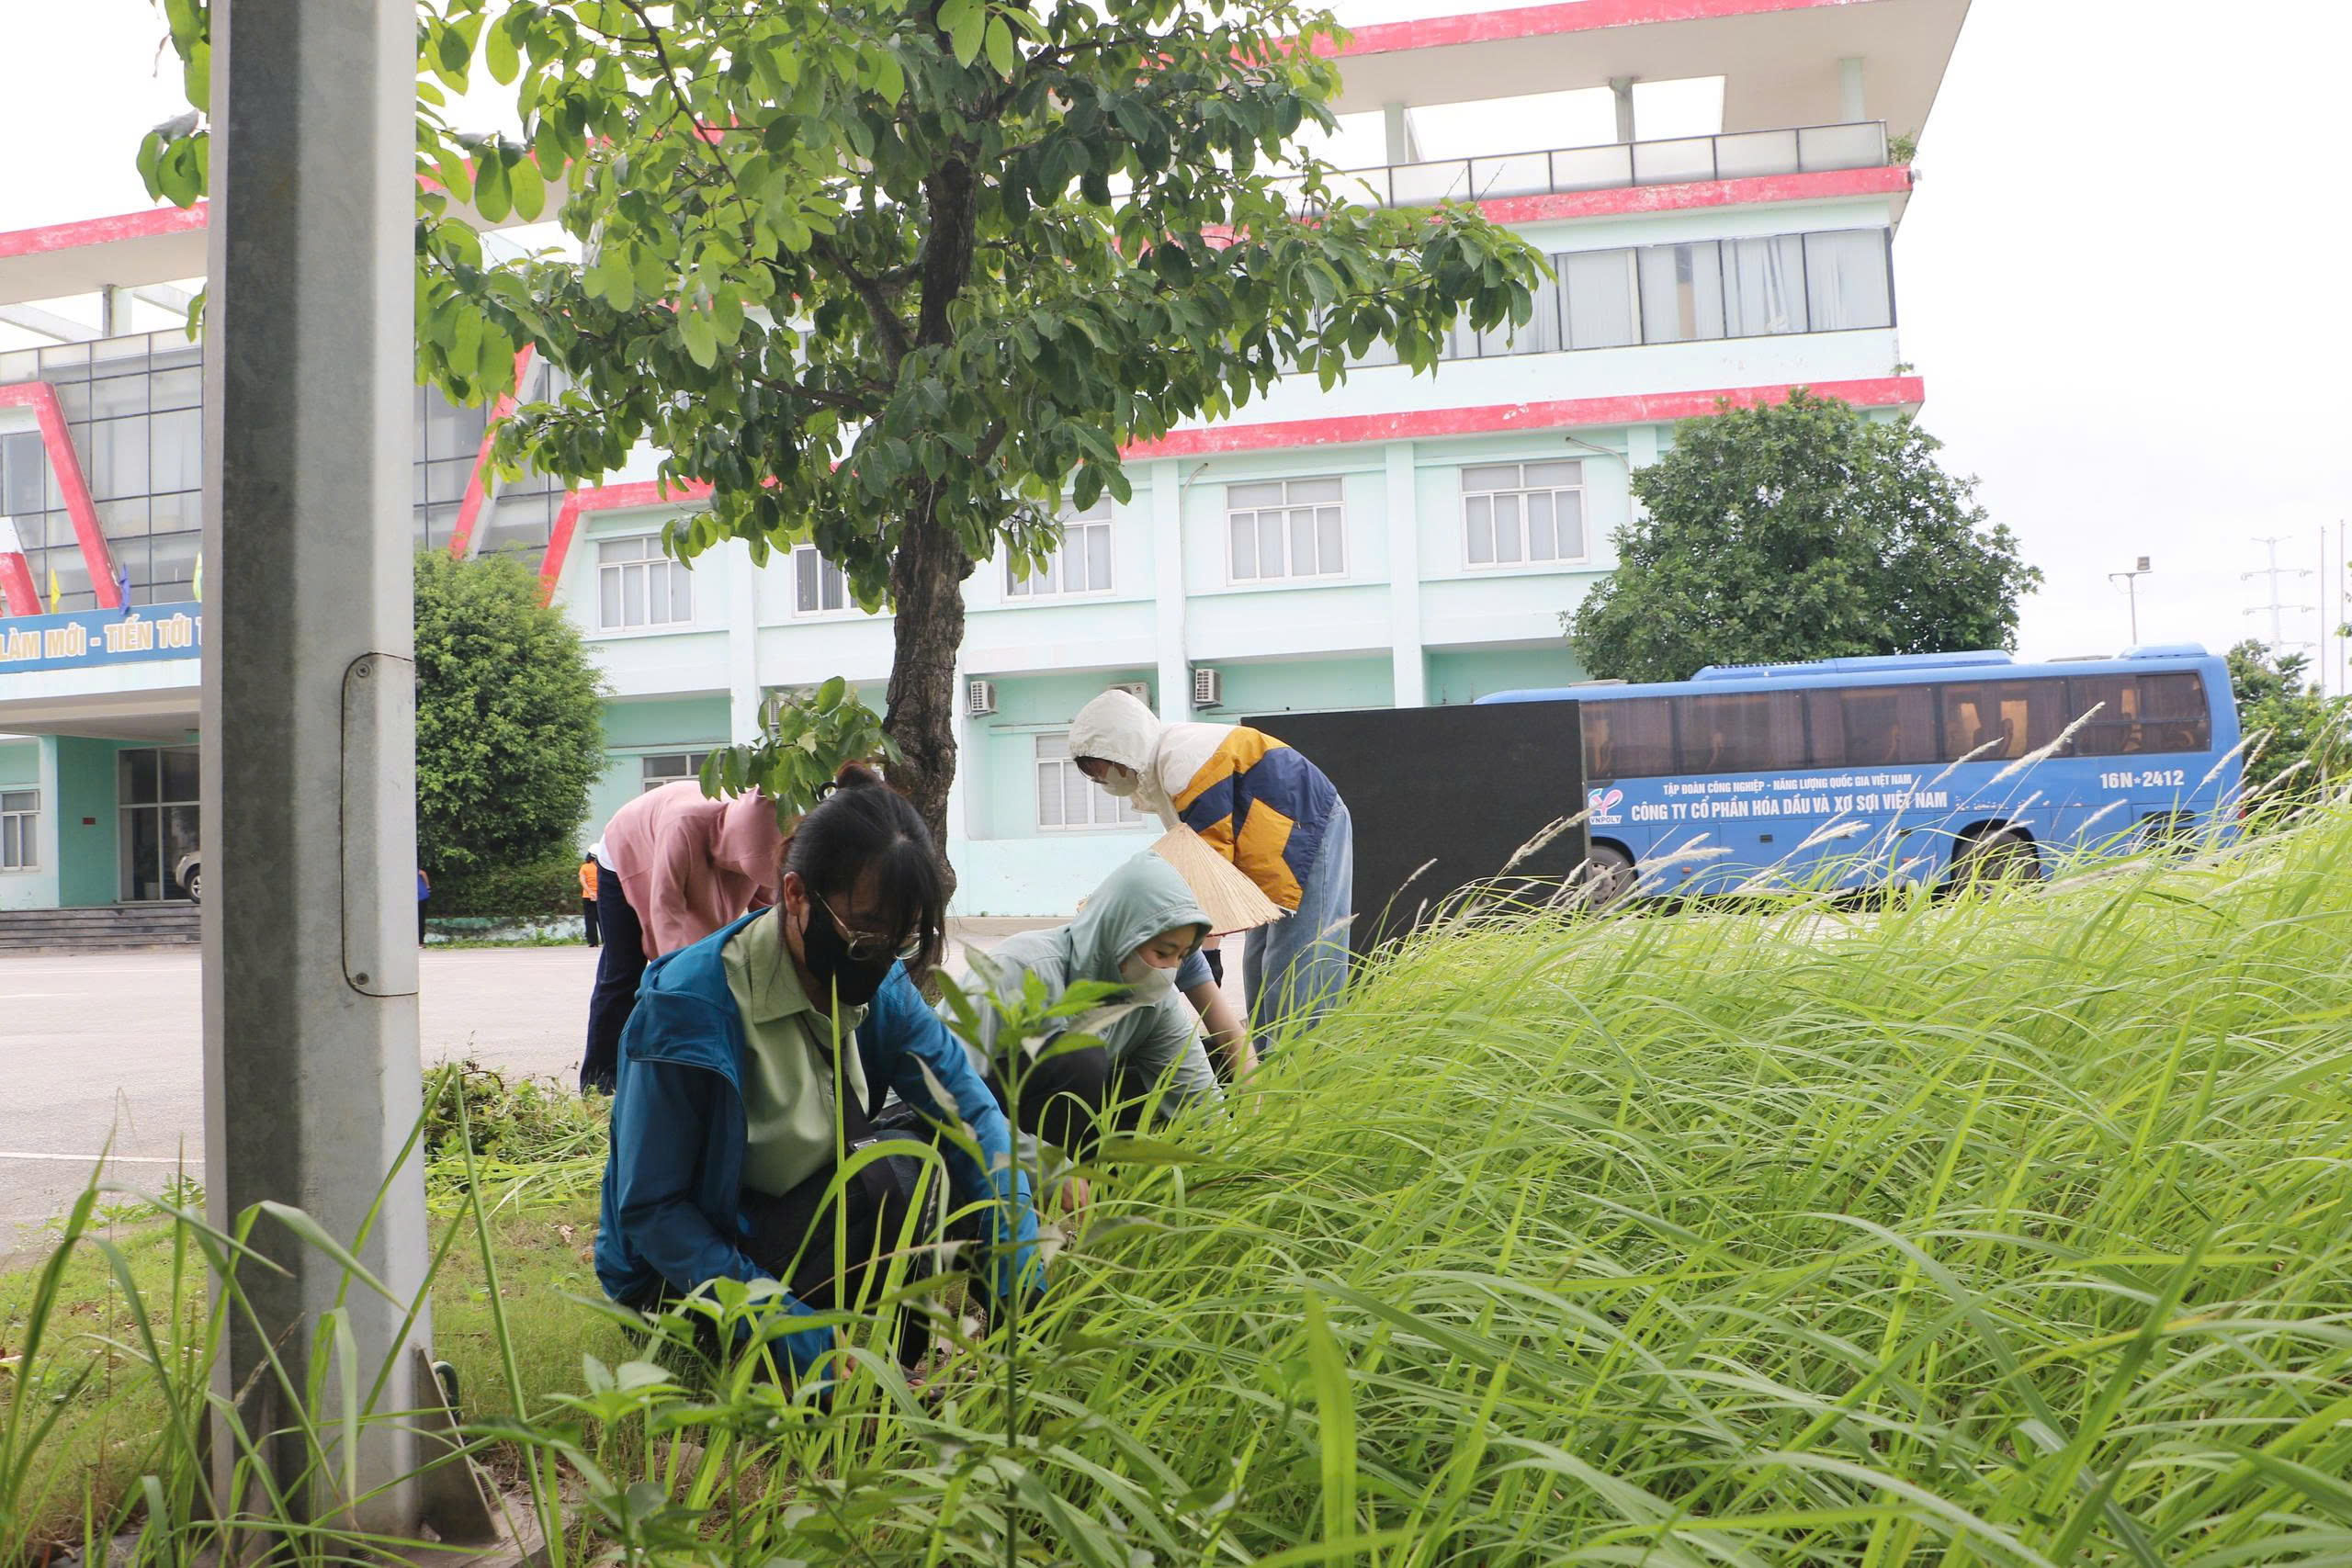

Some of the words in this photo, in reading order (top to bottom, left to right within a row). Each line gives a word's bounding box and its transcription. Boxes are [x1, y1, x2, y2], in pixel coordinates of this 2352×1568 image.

[44, 622, 86, 659] MỚI
[104, 613, 153, 653] TIẾN
[156, 612, 192, 649] TỚI
[1662, 783, 1679, 797] TẬP
[1681, 781, 1706, 795] ĐOÀN
[1707, 781, 1732, 794] CÔNG
[1733, 779, 1765, 794] NGHIỆP
[1773, 777, 1799, 791] NĂNG
[1799, 777, 1828, 792] LƯỢNG
[1829, 773, 1853, 789] QUỐC
[1854, 776, 1871, 787] GIA
[1871, 773, 1890, 788] VIỆT
[1891, 773, 1912, 785] NAM
[1632, 801, 1668, 821] CÔNG
[1671, 803, 1688, 820] TY
[1690, 795, 1711, 819] CỔ
[1712, 795, 1749, 818] PHẦN
[1752, 795, 1780, 817] HÓA
[1782, 793, 1810, 815] DẦU
[1813, 794, 1830, 813] VÀ
[1834, 794, 1853, 812] XƠ
[1856, 792, 1880, 814] SỢI
[1915, 791, 1948, 808] NAM
[1590, 816, 1622, 825] VNPOLY
